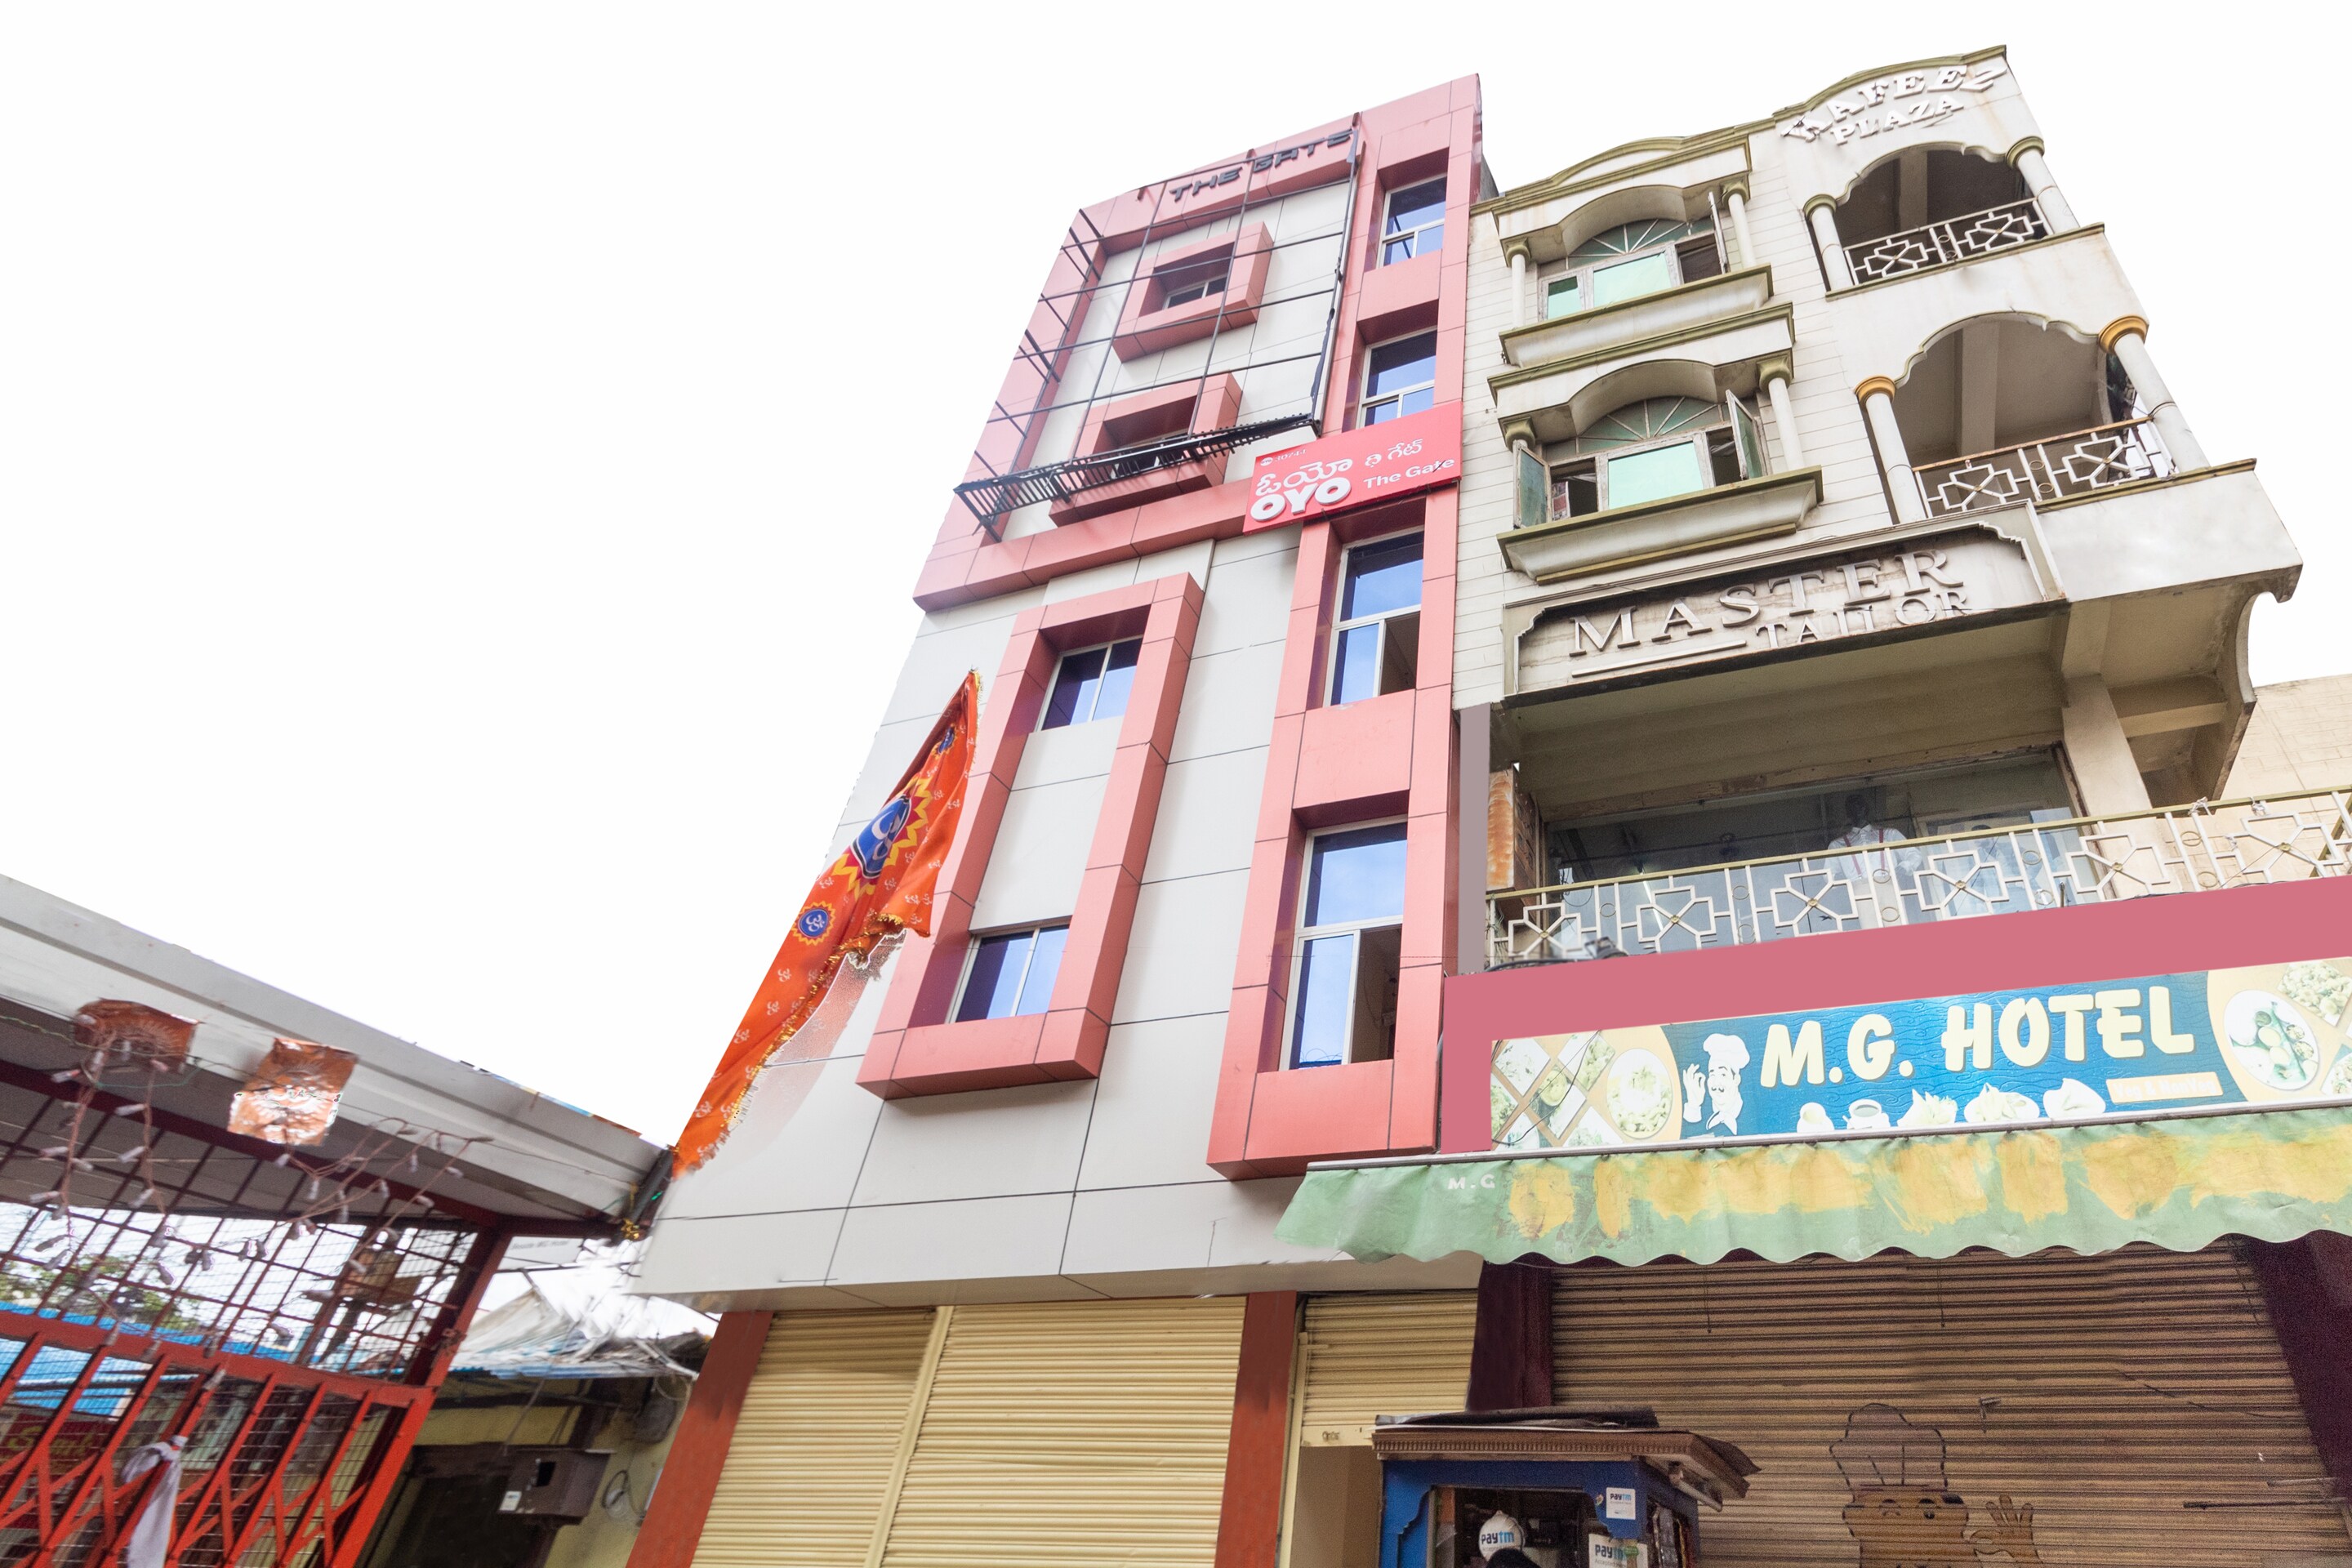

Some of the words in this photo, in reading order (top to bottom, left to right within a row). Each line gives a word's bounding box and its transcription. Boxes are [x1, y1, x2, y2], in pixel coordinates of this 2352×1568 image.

[1830, 94, 1965, 145] PLAZA
[1169, 166, 1243, 203] THE
[1253, 128, 1353, 174] GATE
[1250, 476, 1352, 522] OYO
[1363, 473, 1401, 489] The
[1405, 459, 1455, 479] Gate
[1569, 548, 1964, 657] MASTER
[1755, 590, 1968, 649] TAILOR
[1759, 1013, 1913, 1089] M.G.
[1940, 985, 2195, 1073] HOTEL
[2111, 1083, 2144, 1100] Veg
[2144, 1080, 2157, 1096] &
